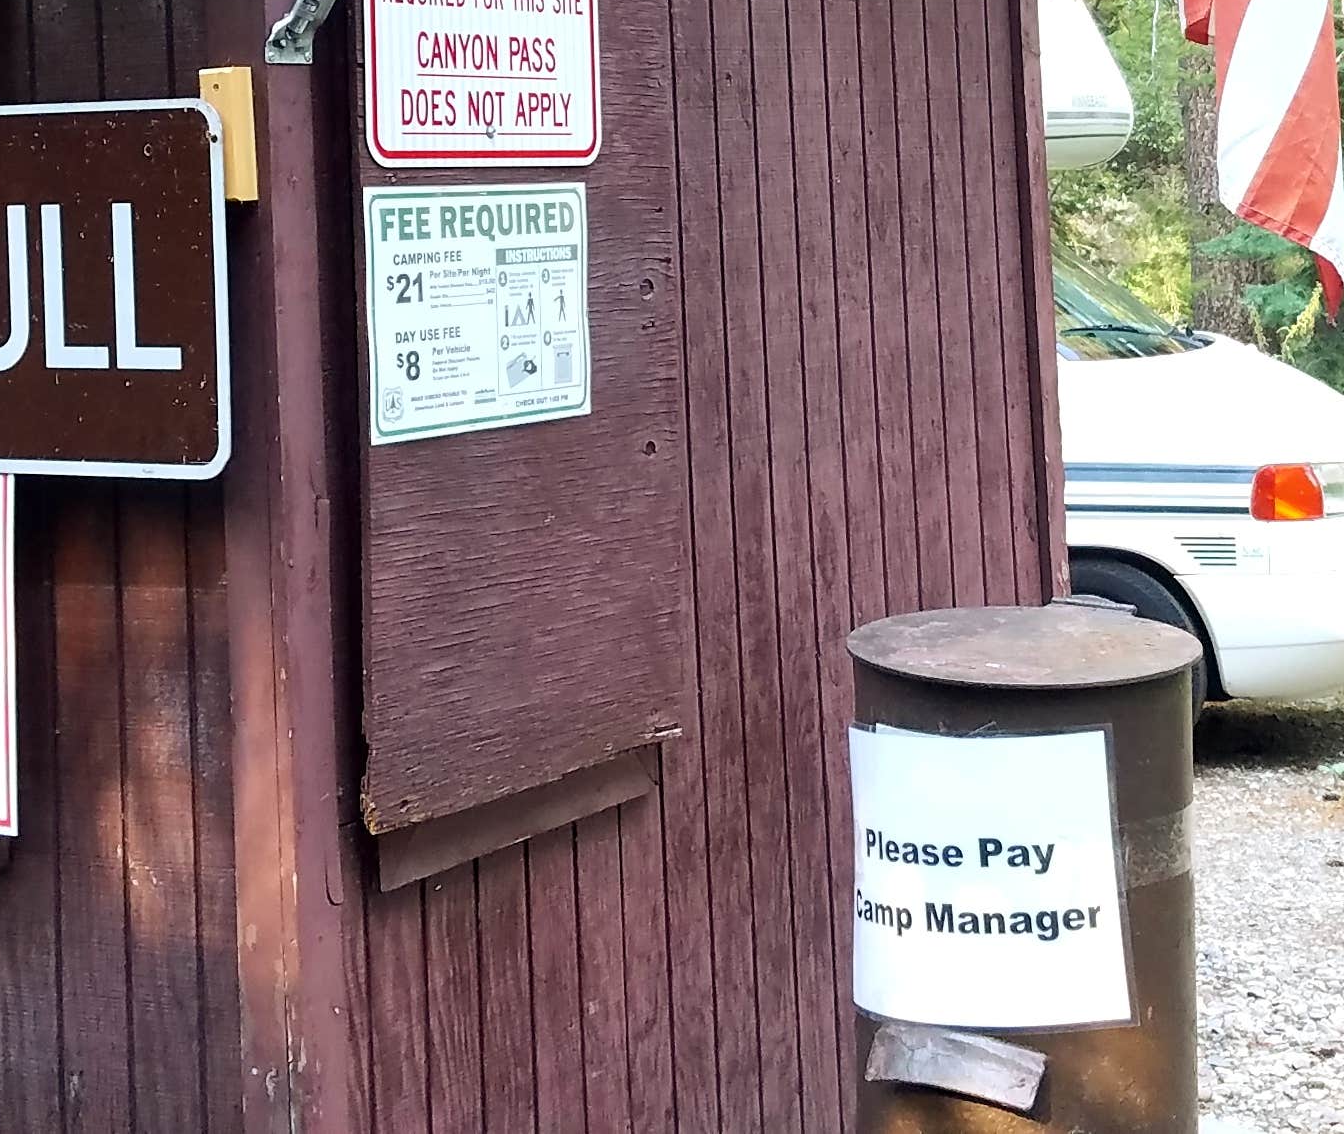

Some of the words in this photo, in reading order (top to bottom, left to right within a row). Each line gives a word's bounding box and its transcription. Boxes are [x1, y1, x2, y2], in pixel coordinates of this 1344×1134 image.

[417, 31, 498, 70] CANYON
[509, 37, 556, 72] PASS
[401, 89, 457, 126] DOES
[468, 91, 505, 127] NOT
[515, 92, 572, 127] APPLY
[380, 206, 431, 242] FEE
[440, 202, 575, 241] REQUIRED
[393, 252, 441, 265] CAMPING
[443, 250, 462, 262] FEE
[505, 247, 572, 264] INSTRUCTIONS
[472, 267, 490, 277] Night
[387, 272, 424, 304] $21
[396, 331, 416, 344] DAY
[419, 329, 440, 341] USE
[443, 327, 461, 339] FEE
[446, 346, 470, 354] Vehicle
[396, 350, 420, 381] $8
[516, 399, 534, 407] CHECK
[866, 829, 963, 867] Please
[979, 838, 1055, 874] Pay
[856, 889, 912, 936] Camp
[925, 903, 1101, 941] Manager
